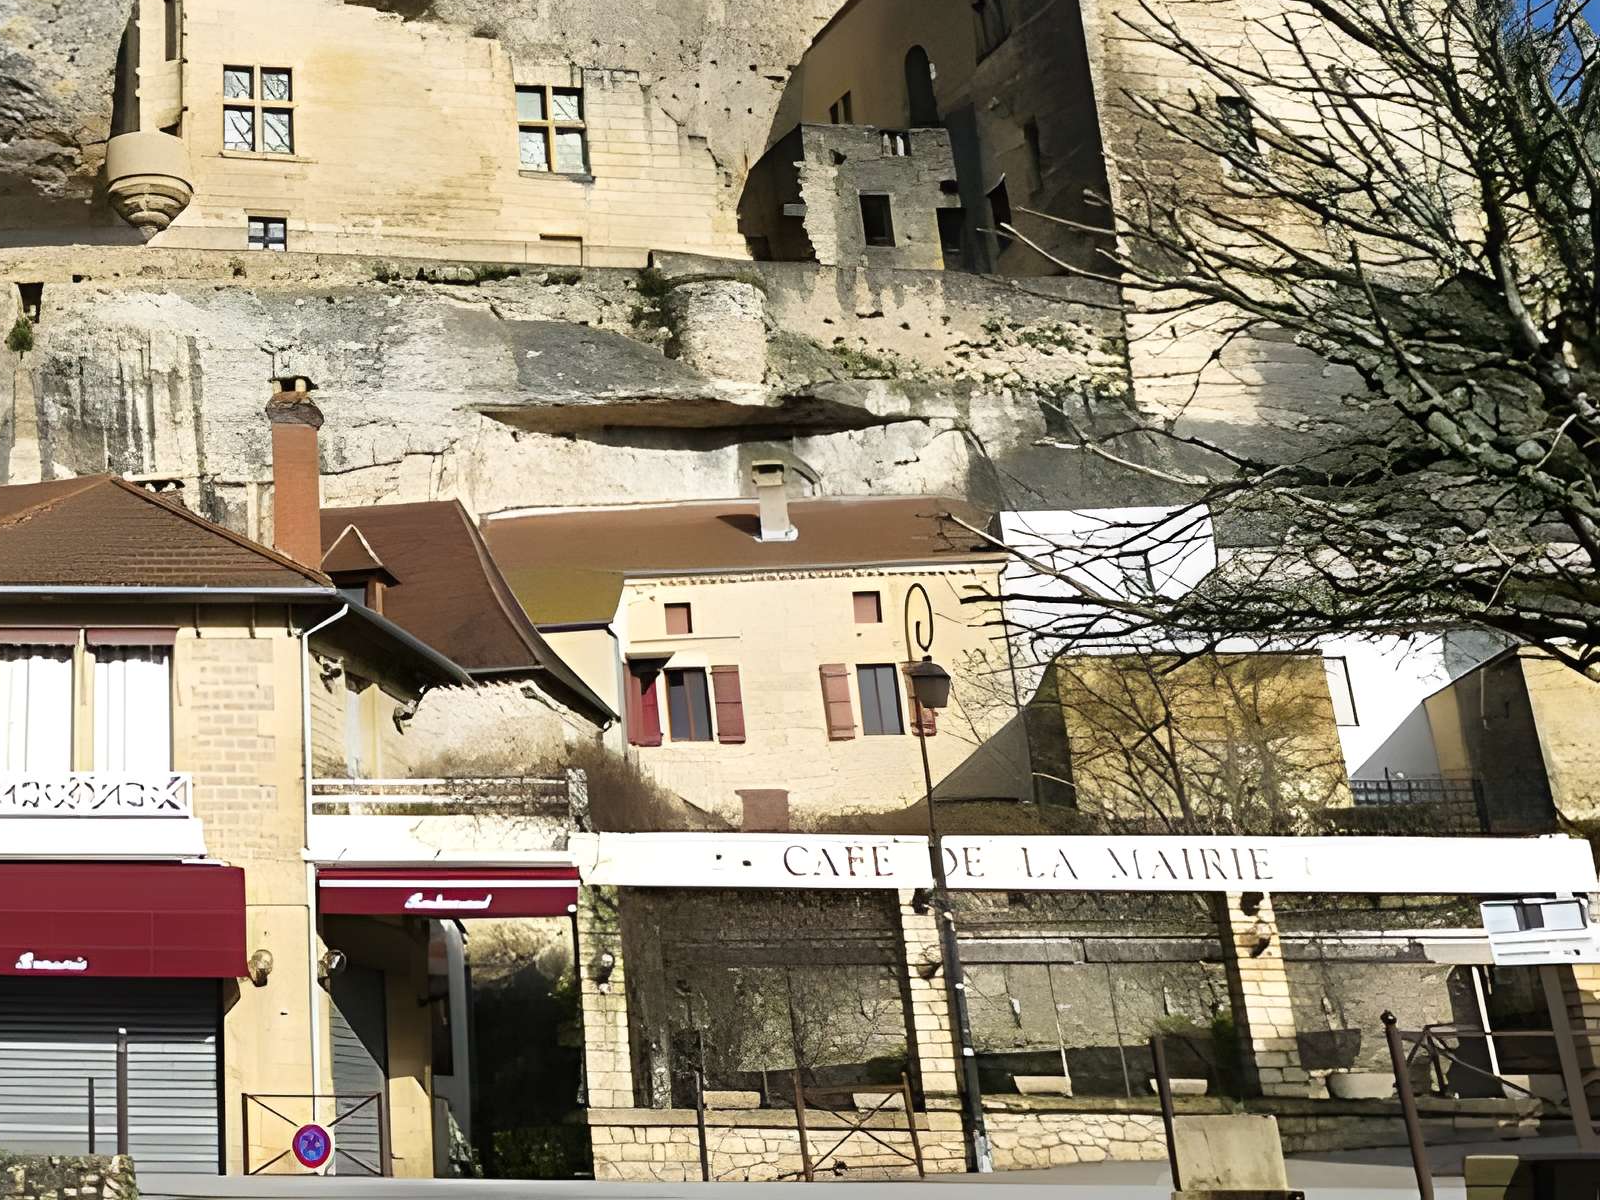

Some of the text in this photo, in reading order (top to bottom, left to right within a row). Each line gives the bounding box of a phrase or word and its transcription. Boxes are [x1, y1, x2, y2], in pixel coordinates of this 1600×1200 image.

[942, 846, 985, 878] DE
[1020, 846, 1079, 880] LA
[1106, 846, 1274, 880] MAIRIE
